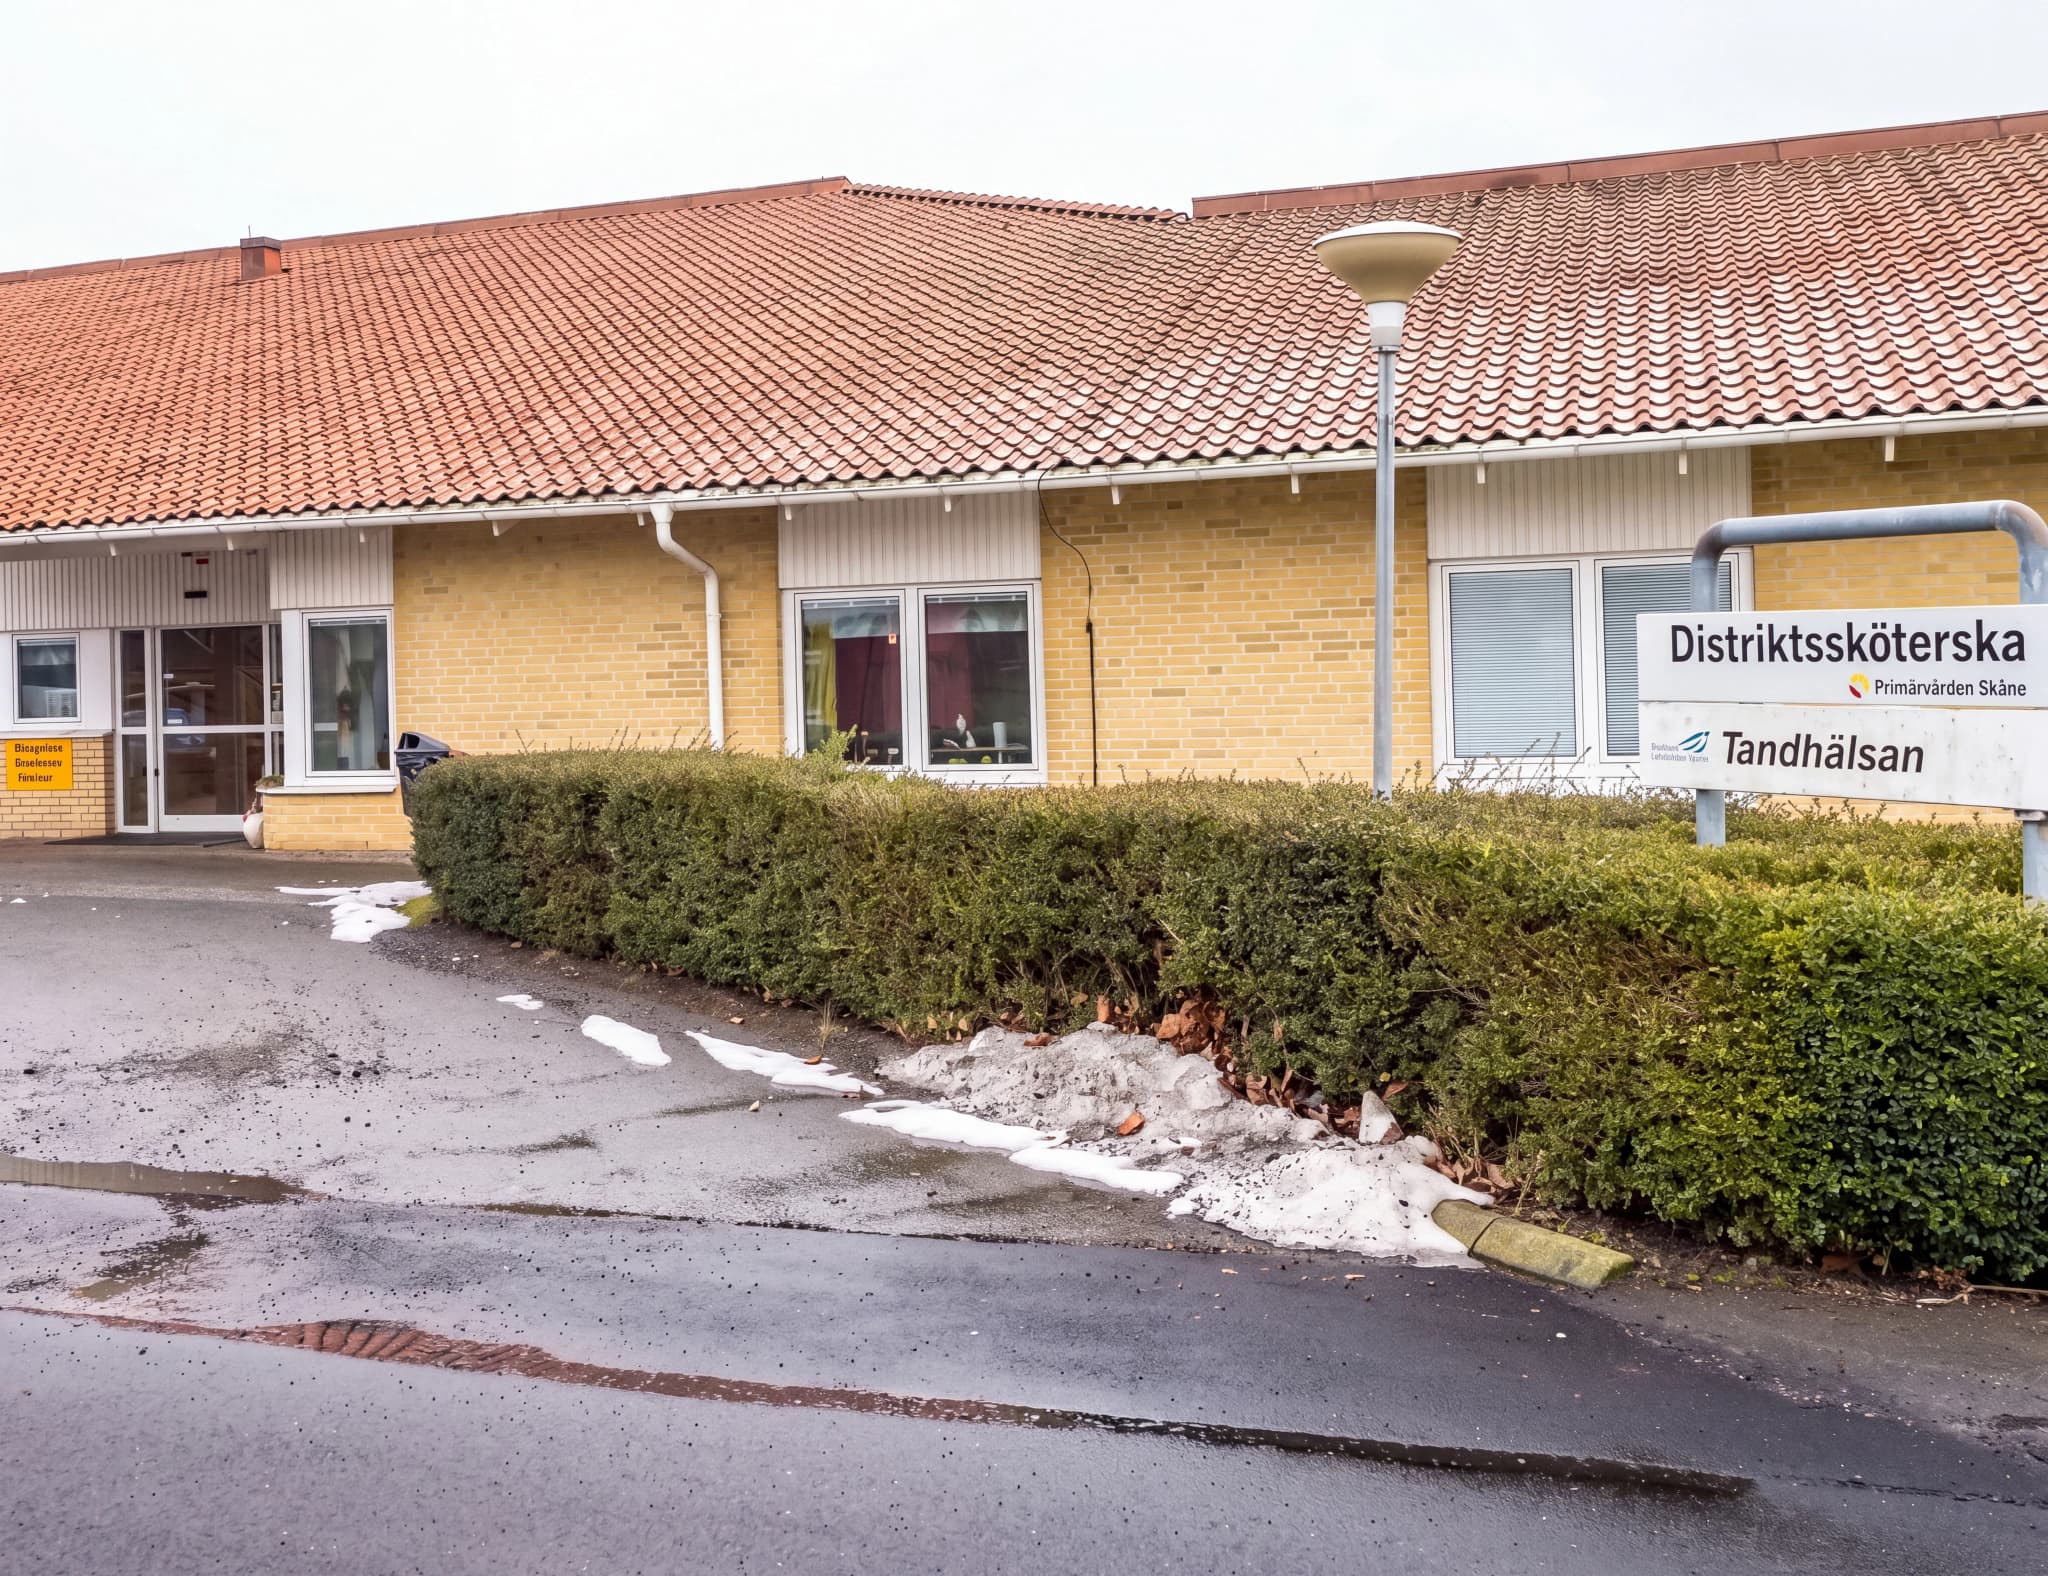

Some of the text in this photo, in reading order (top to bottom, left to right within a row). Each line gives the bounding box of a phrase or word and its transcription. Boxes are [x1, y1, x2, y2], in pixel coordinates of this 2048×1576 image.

[1671, 619, 2026, 663] Distriktssköterska
[1874, 678, 2027, 697] Primärvården Skåne
[1722, 731, 1924, 773] Tandhälsan
